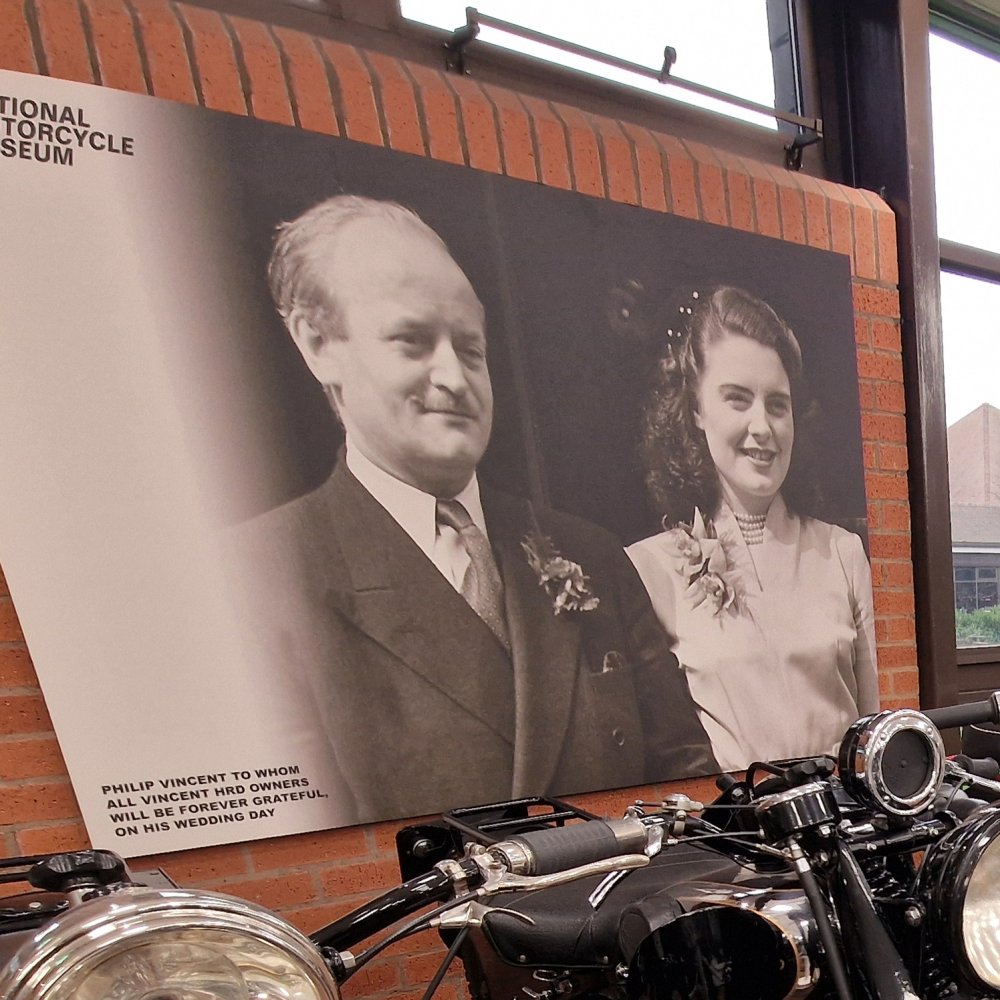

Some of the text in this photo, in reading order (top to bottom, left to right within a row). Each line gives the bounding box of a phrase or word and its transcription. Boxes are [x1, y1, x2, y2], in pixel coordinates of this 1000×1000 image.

[1, 117, 135, 156] TORCYCLE
[101, 765, 300, 795] PHILIP VINCENT TO WHOM
[106, 777, 310, 810] ALL VINCENT HRD OWNERS
[109, 788, 329, 823] WILL BE FOREVER GRATEFUL,
[115, 808, 276, 837] ON HIS WEDDING DAY
